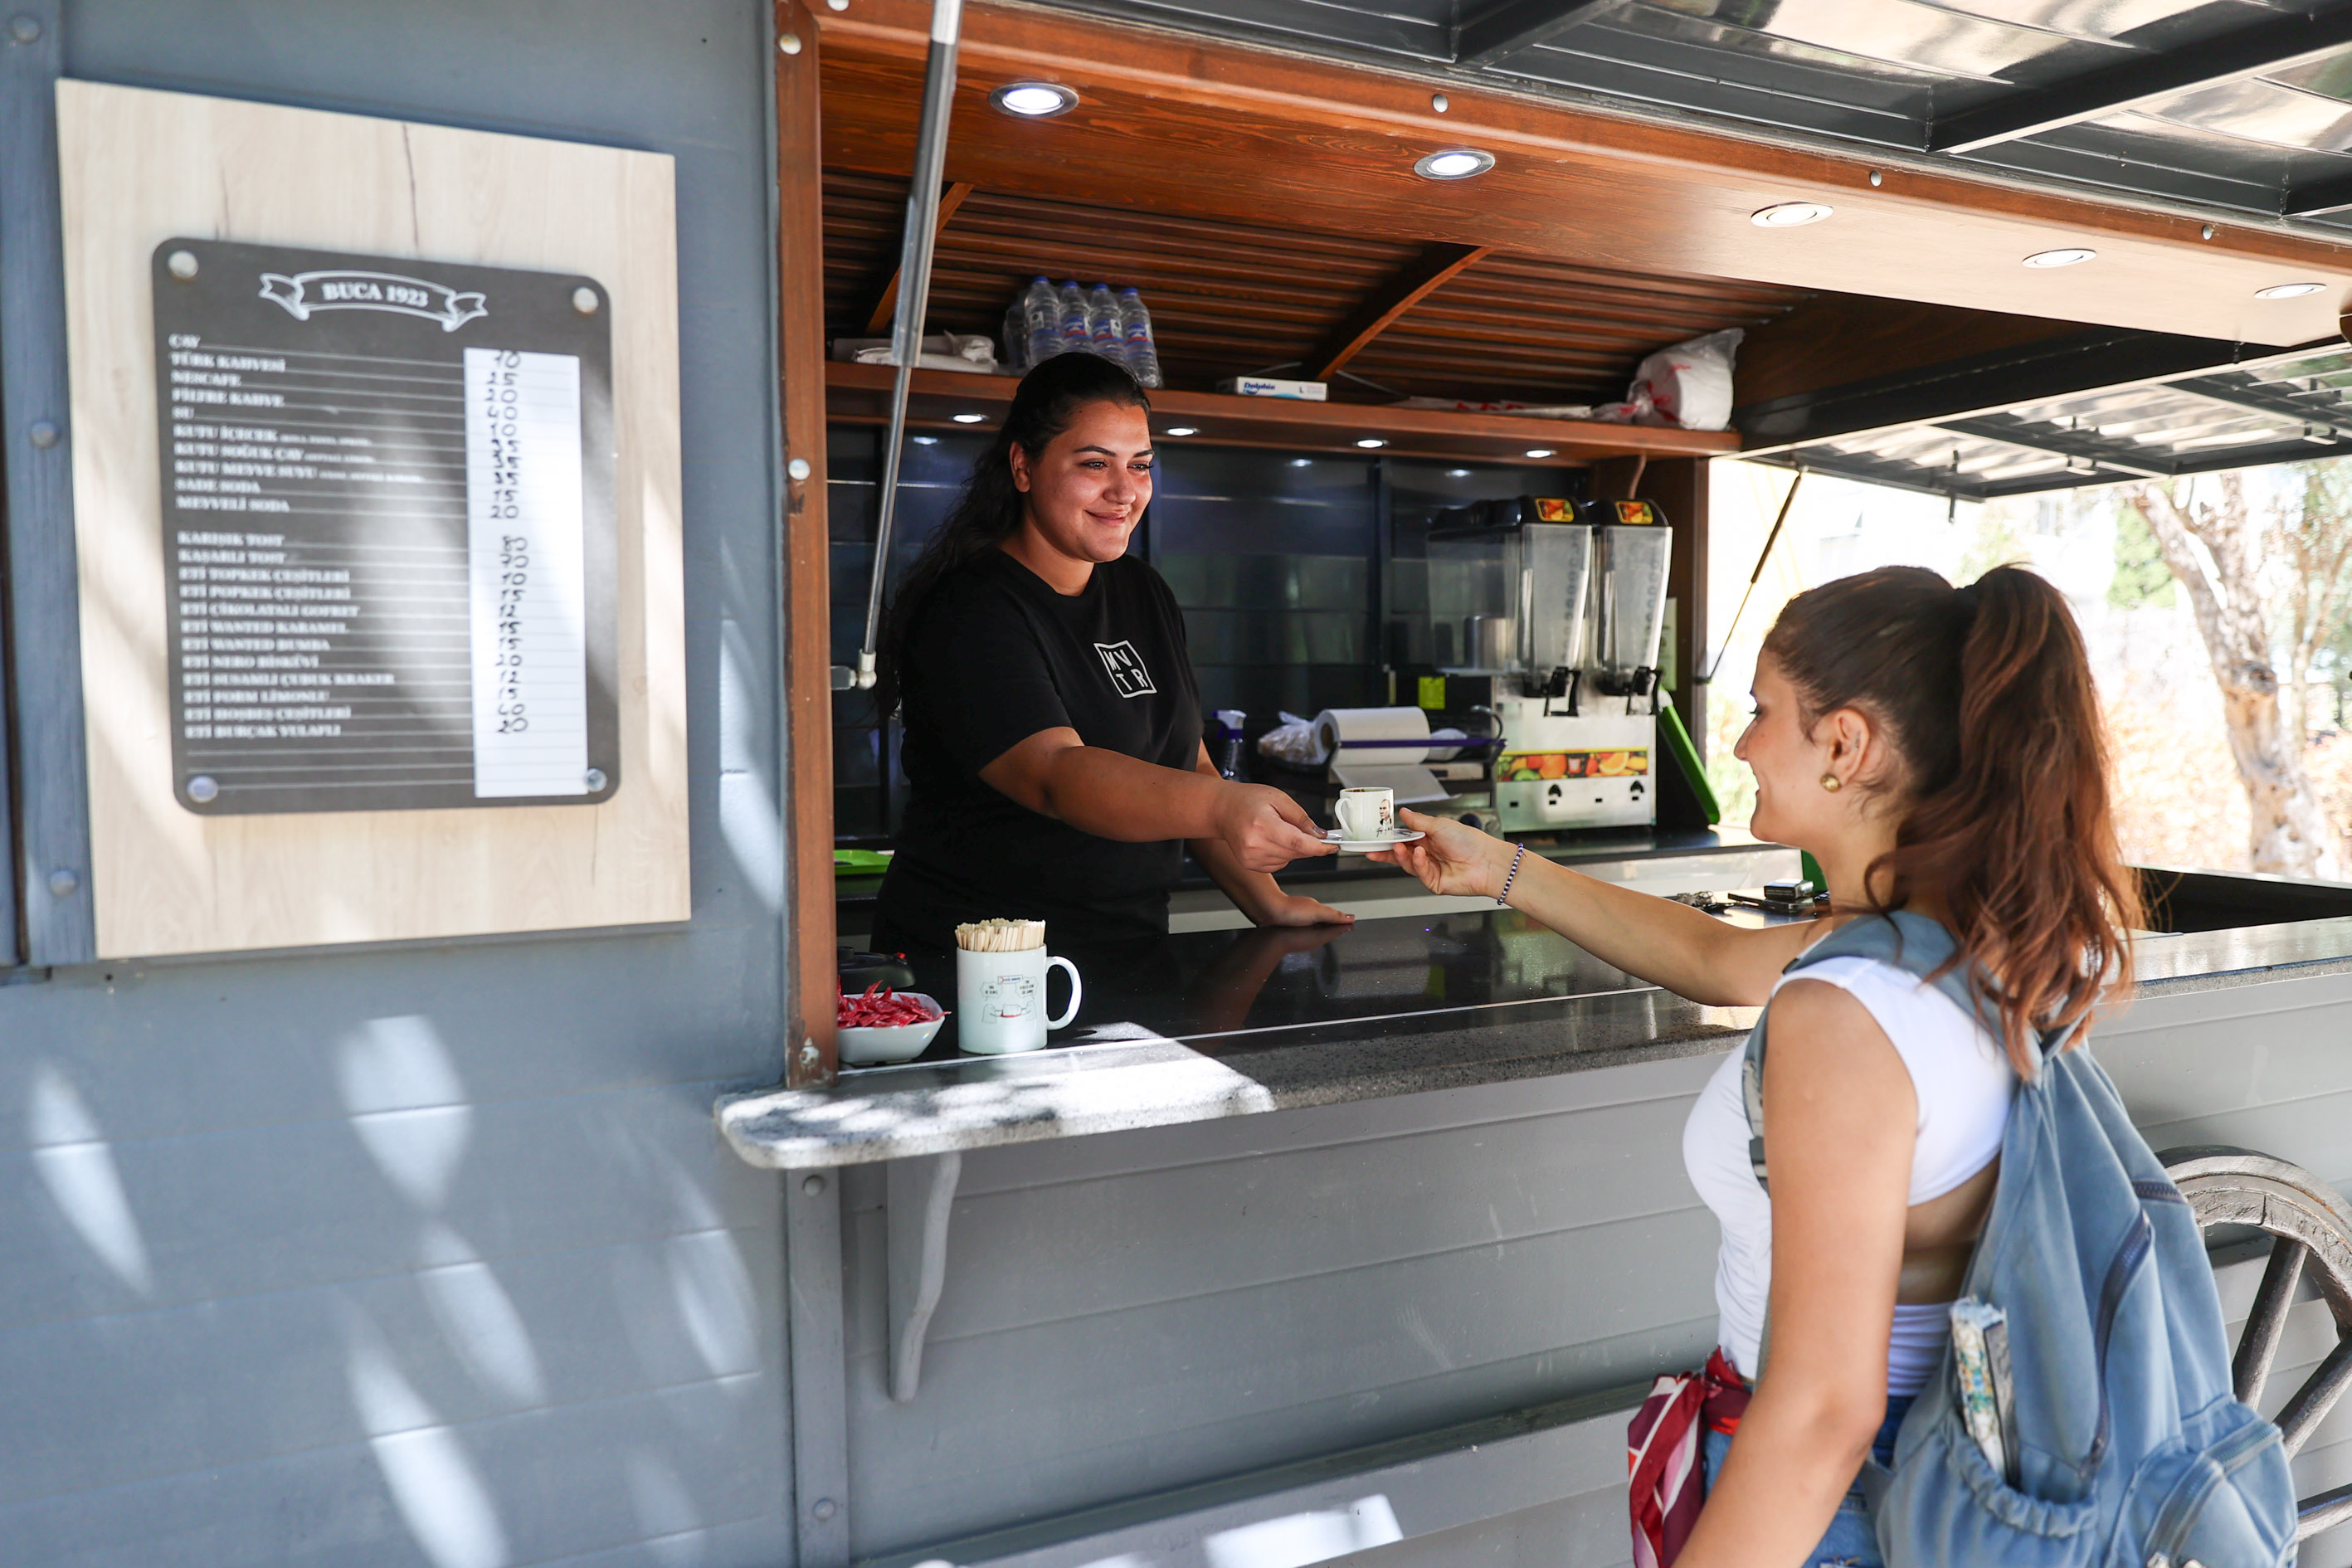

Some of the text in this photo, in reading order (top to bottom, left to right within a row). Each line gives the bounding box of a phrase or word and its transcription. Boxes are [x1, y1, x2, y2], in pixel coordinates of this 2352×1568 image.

[321, 282, 429, 308] BUCA 1923
[169, 351, 286, 373] TÜRK KAHVESİ
[228, 392, 285, 408] KAHVE
[485, 388, 518, 403] 20
[171, 406, 194, 420] SU
[173, 423, 218, 440] KUTU
[490, 422, 516, 436] 10
[173, 441, 219, 457] KUTU
[174, 459, 219, 475] KUTU
[220, 460, 276, 478] MEYVE
[173, 477, 261, 494] SADE SODA
[494, 489, 518, 502] 15
[175, 494, 290, 513] MEYVELİ SODA
[489, 505, 519, 519] 20
[246, 533, 285, 547] TOST
[247, 550, 287, 565] TOST
[502, 572, 526, 586] 10
[501, 589, 525, 601] 15
[499, 604, 516, 617] 12
[499, 621, 522, 634] 15
[499, 637, 522, 650] 15
[495, 654, 522, 666] 20
[500, 670, 520, 684] 12
[499, 687, 519, 699] 15
[496, 718, 528, 733] 20
